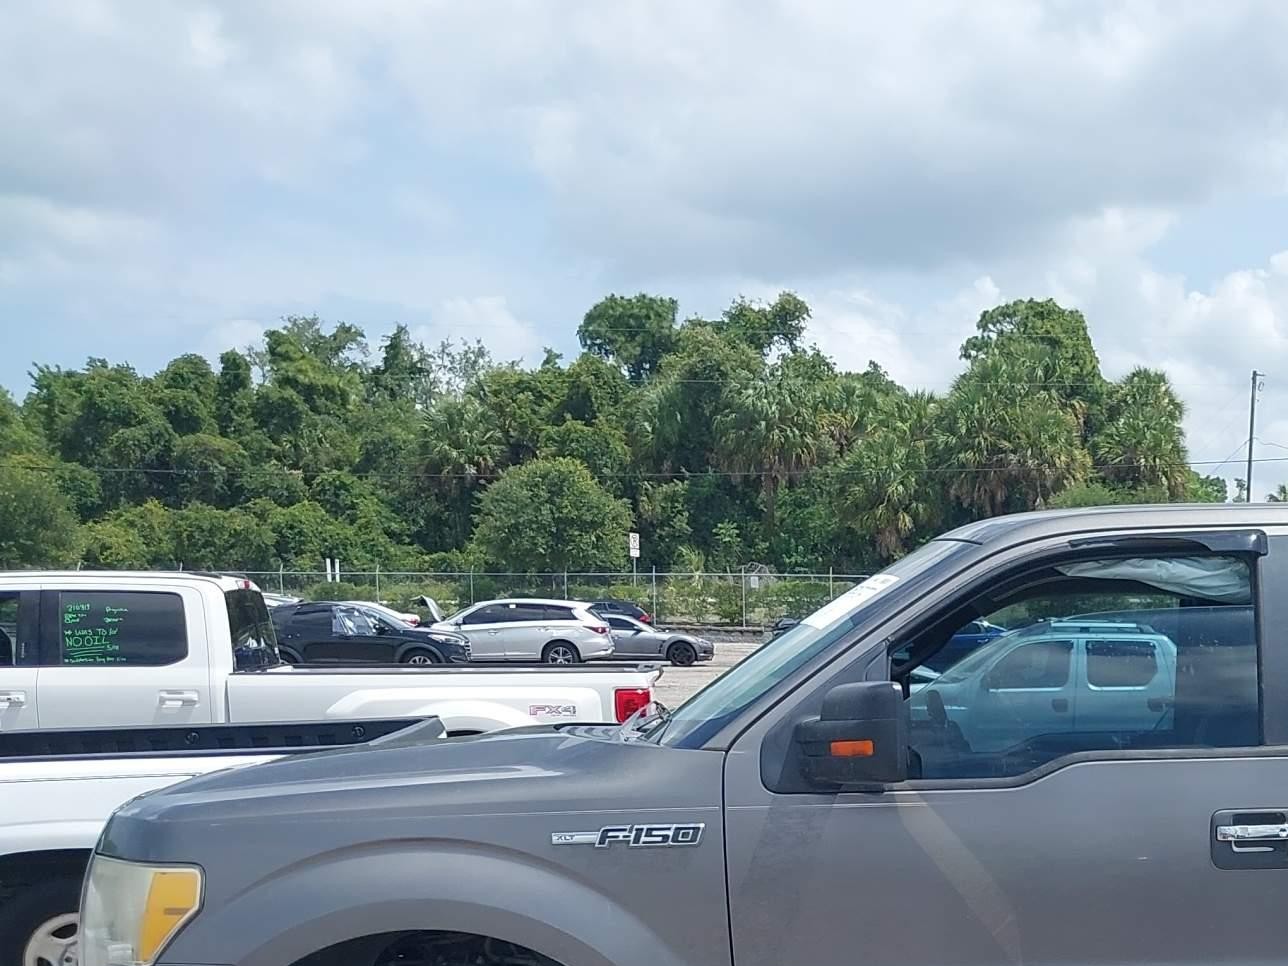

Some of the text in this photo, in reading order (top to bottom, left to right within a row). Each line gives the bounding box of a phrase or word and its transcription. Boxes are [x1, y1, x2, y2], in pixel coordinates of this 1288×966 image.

[65, 635, 110, 648] NO OIL
[529, 704, 577, 716] FX4
[554, 833, 576, 842] XLT
